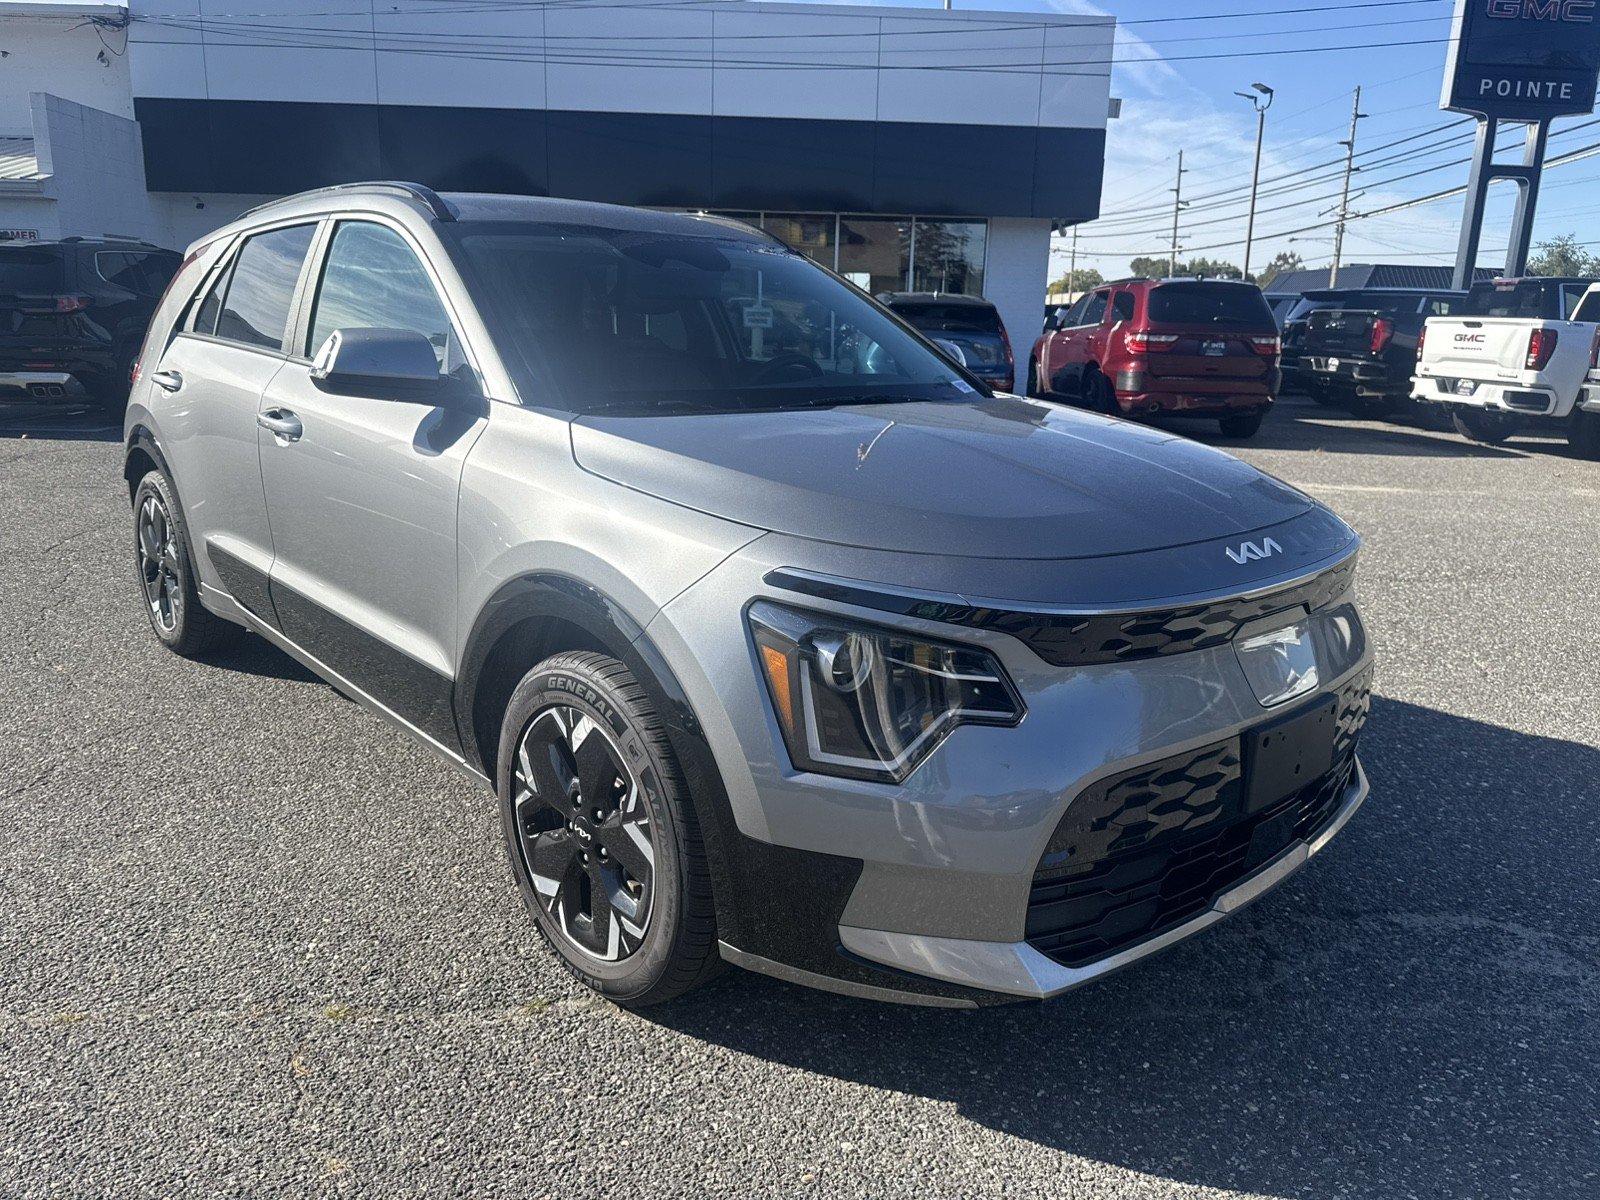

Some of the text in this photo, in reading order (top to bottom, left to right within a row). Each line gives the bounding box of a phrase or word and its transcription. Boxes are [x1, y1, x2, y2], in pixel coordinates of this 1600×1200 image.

[1486, 0, 1596, 22] GMC
[1480, 79, 1573, 99] POINTE
[1454, 333, 1486, 343] GMC
[1225, 537, 1283, 565] KIA
[547, 676, 614, 726] GENERAL
